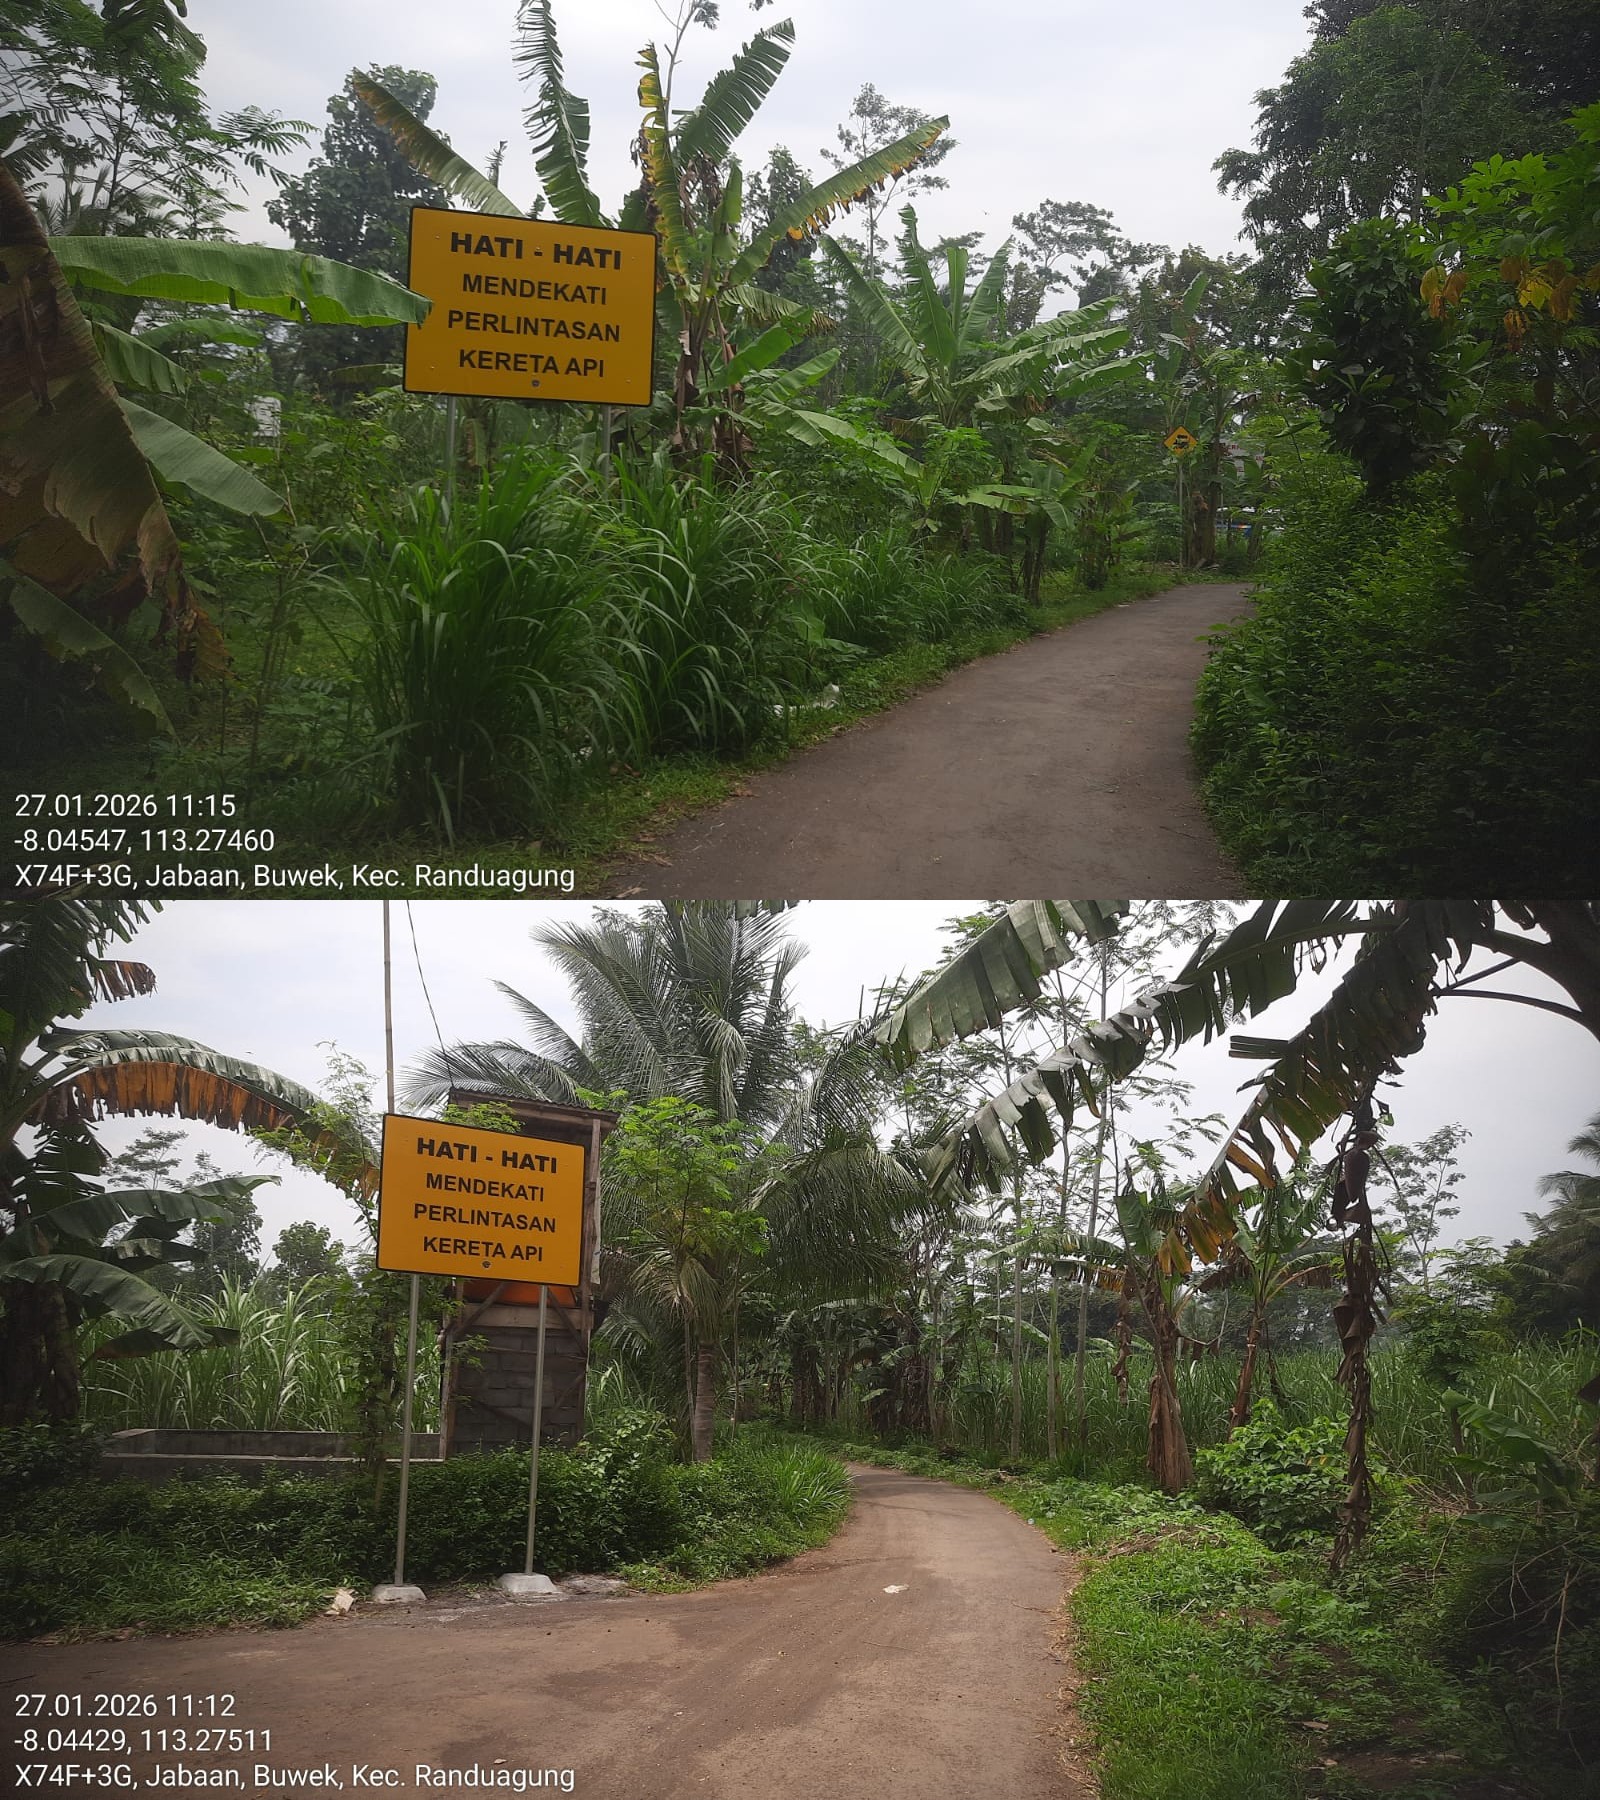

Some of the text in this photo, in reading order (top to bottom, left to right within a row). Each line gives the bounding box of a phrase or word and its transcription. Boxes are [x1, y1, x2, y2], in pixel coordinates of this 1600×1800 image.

[451, 232, 523, 259] HATI
[553, 243, 621, 270] HATI
[463, 274, 606, 305] MENDEKATI
[448, 310, 620, 342] PERLINTASAN
[459, 349, 604, 378] KERETA API
[417, 1137, 477, 1163] HATI
[501, 1150, 557, 1174] HATI
[426, 1173, 544, 1202] MENDEKATI
[414, 1203, 556, 1233] PERLINTASAN
[423, 1236, 543, 1262] KERETA API
